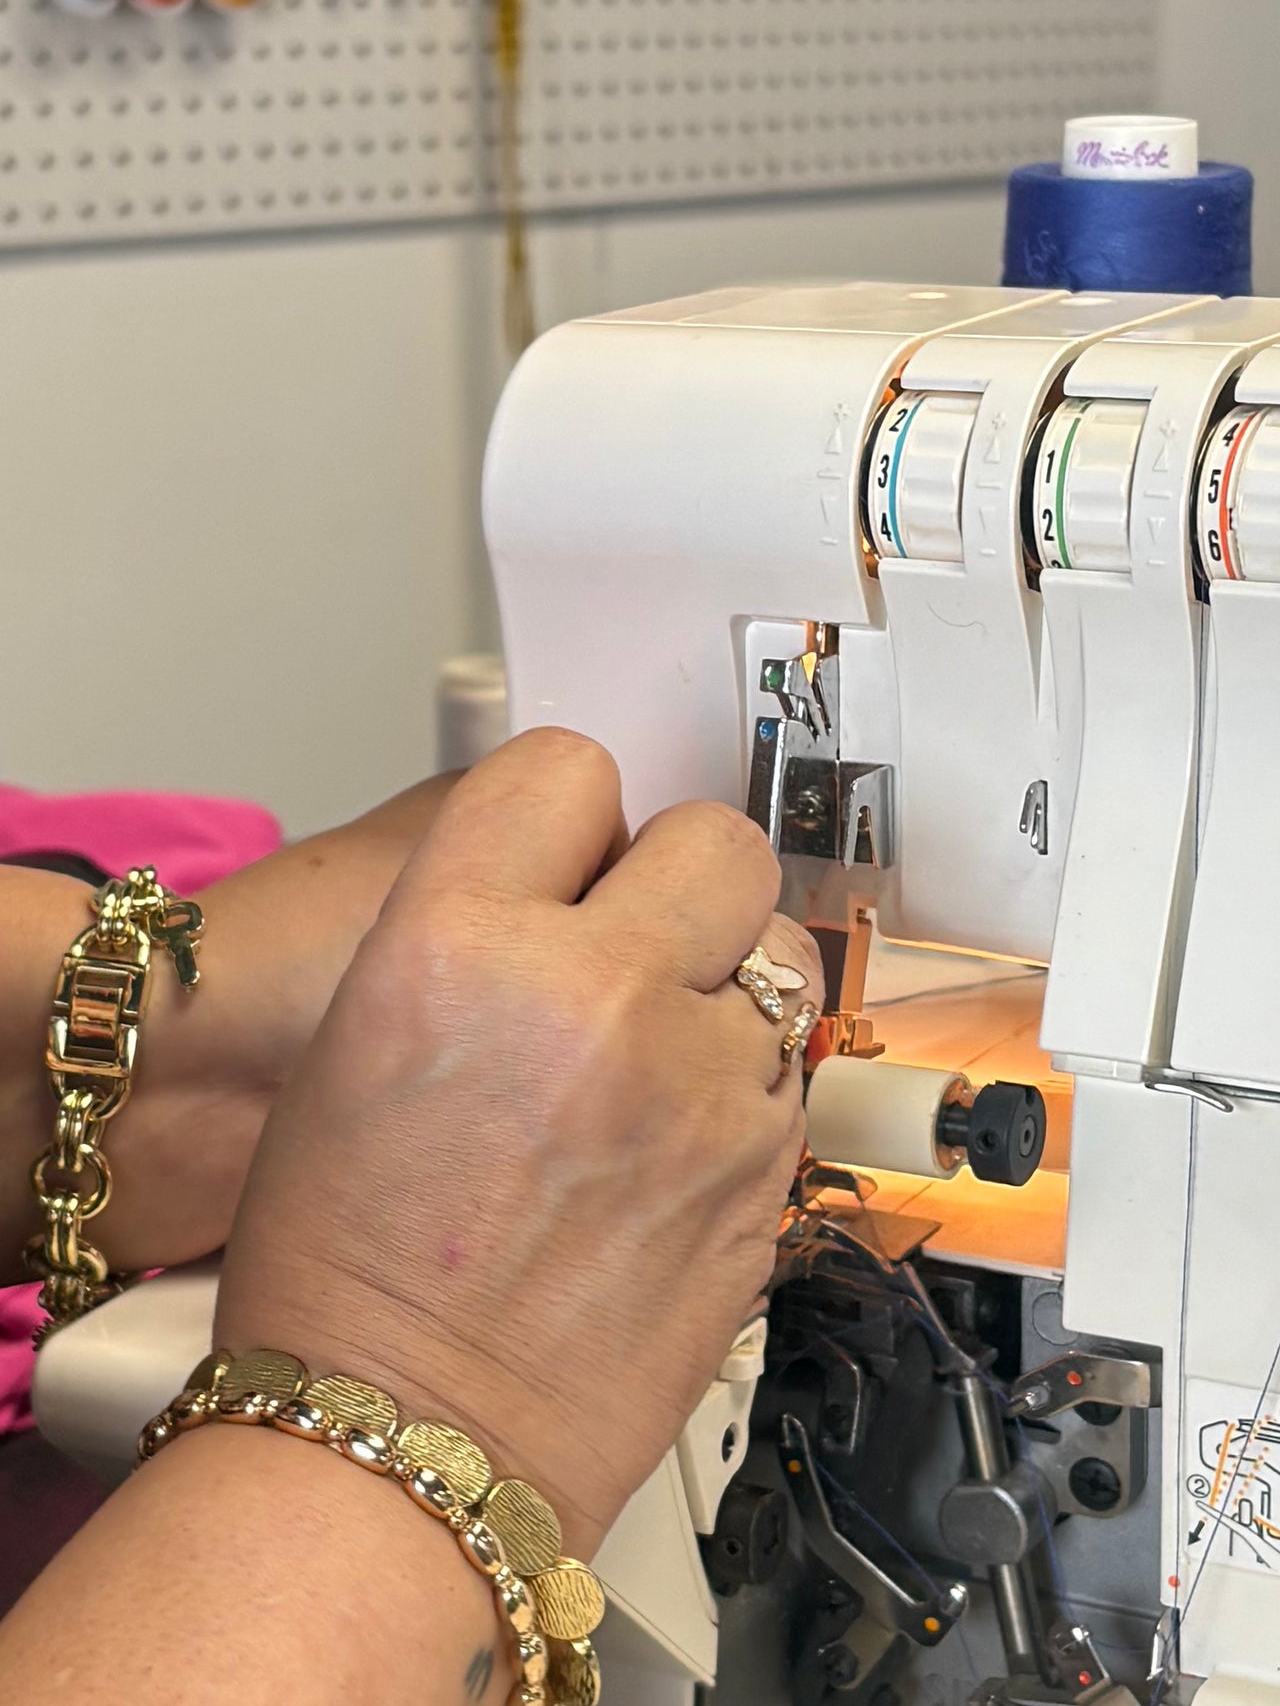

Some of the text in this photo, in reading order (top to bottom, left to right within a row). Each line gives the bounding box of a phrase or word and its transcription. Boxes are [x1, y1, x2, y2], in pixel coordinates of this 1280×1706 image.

[889, 409, 908, 432] 2
[1223, 422, 1240, 446] 4
[878, 454, 890, 488] 3
[1046, 450, 1055, 483] 1
[1208, 469, 1221, 503] 5
[881, 513, 893, 542] 4
[1042, 509, 1054, 541] 2
[1208, 529, 1221, 561] 6
